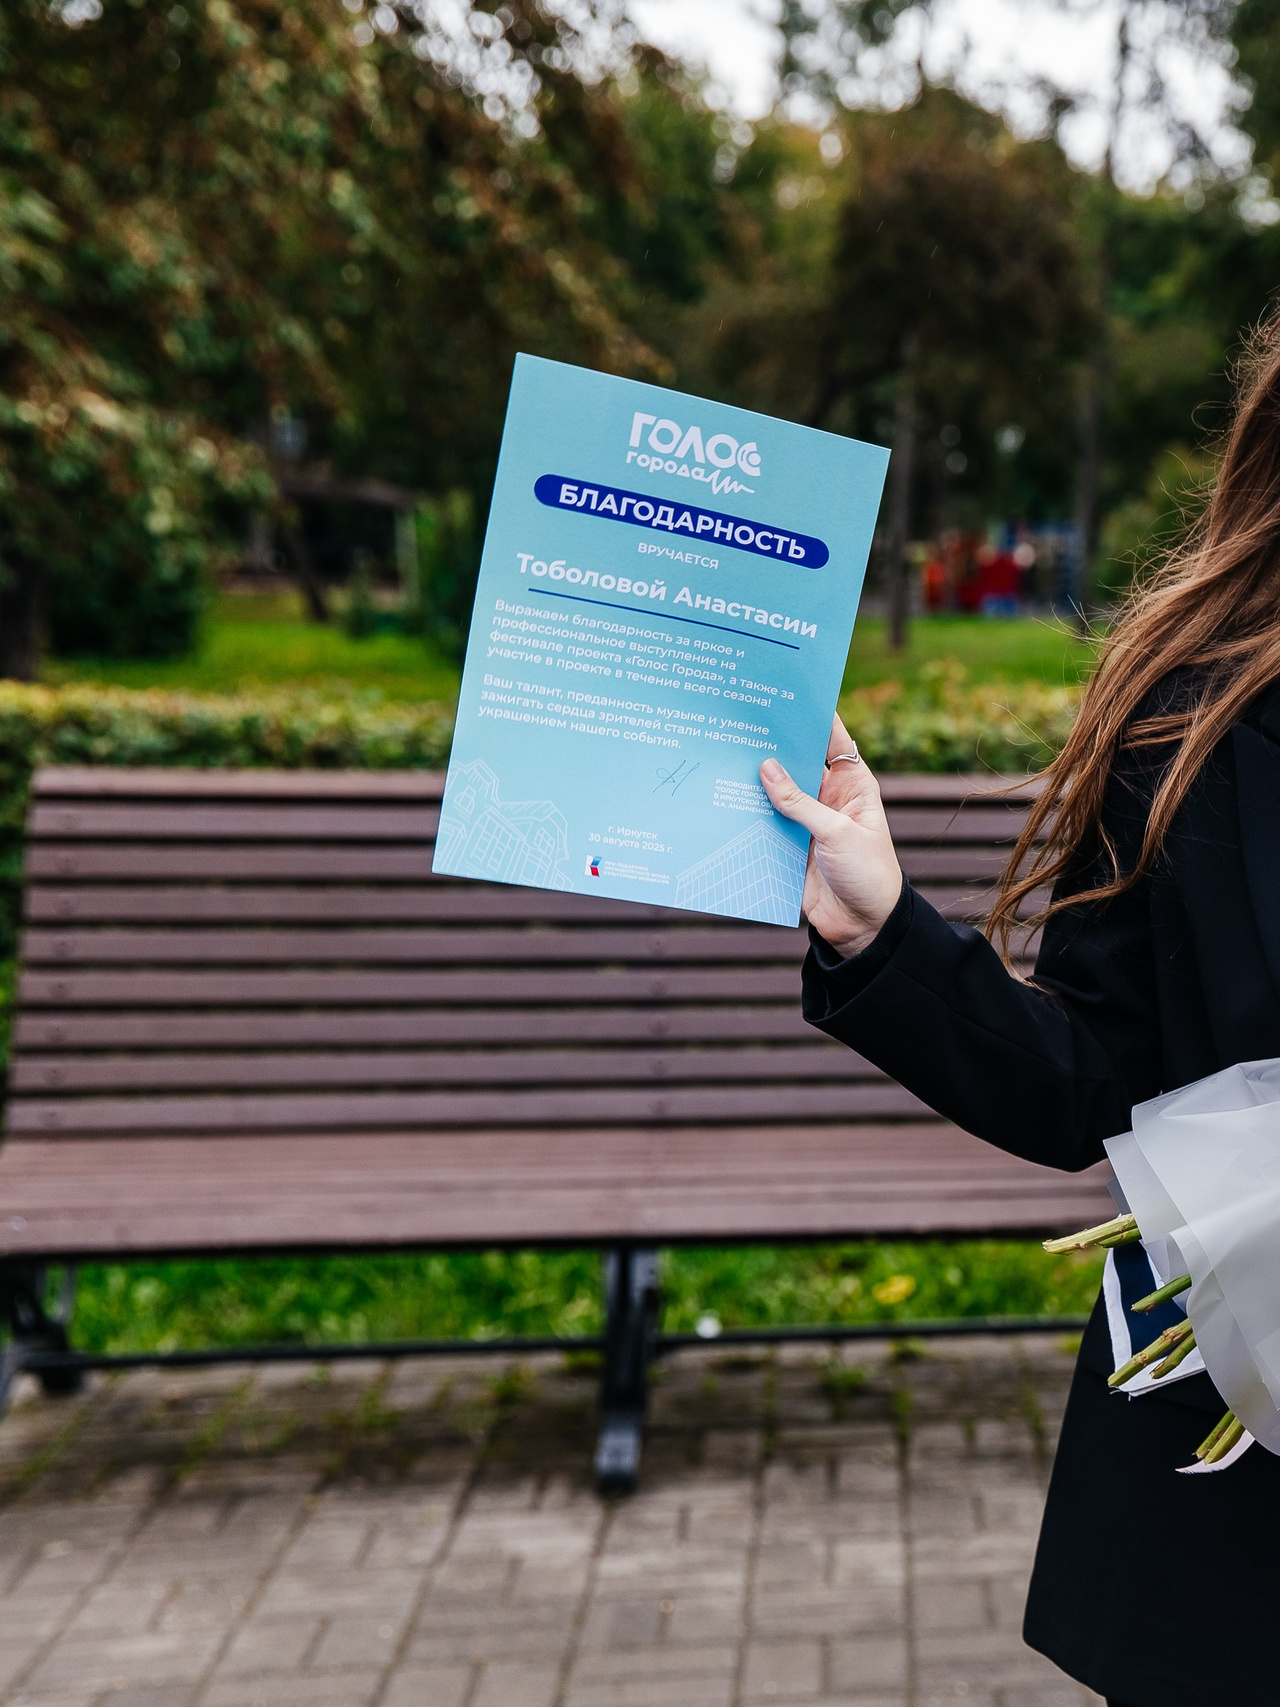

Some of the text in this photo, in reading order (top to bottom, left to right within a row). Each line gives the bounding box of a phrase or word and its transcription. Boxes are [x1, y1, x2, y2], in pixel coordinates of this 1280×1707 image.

[629, 412, 761, 476] ГОЛОС
[559, 484, 805, 559] БЛАГОДАРНОСТЬ
[638, 542, 719, 569] ВРУЧАЕТСЯ
[517, 552, 817, 638] Тоболовой Анастасии
[492, 616, 736, 670] профессиональное выступление на
[495, 599, 745, 658] Выражаем благодарность за яркое и
[487, 646, 771, 707] участие в проекте в течение всего сезона!
[490, 629, 794, 700] фестивале проекта «Голос Города», а также за
[478, 705, 681, 748] украшением нашего события.
[481, 691, 777, 751] зажигать сердца зрителей стали настоящим
[484, 674, 769, 735] Ваш талант, преданность музыке и умение
[715, 778, 766, 792] РУКОВОДИТЕЛ
[720, 793, 760, 806] ИРКУТСКОЙ
[588, 833, 601, 842] 30
[603, 837, 640, 848] августа
[642, 841, 665, 852] 2025
[617, 826, 658, 839] Иркутск
